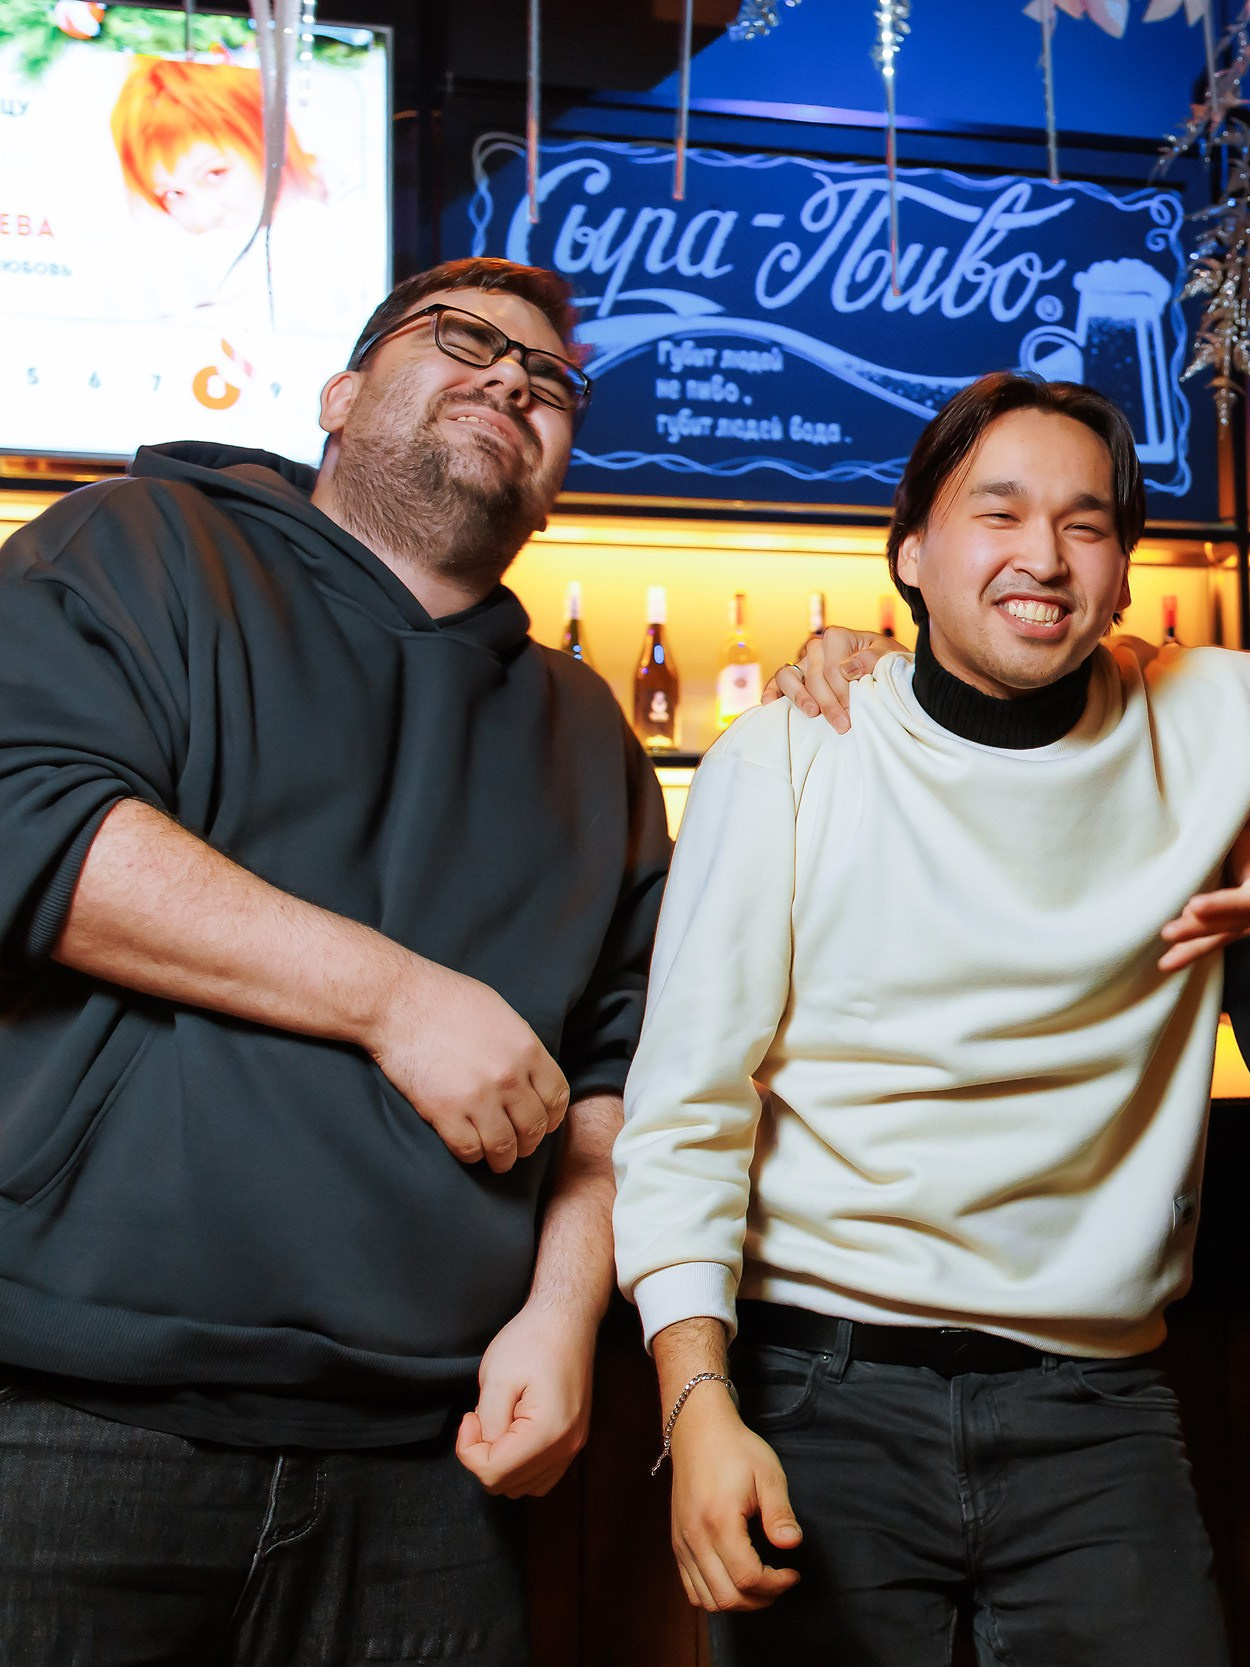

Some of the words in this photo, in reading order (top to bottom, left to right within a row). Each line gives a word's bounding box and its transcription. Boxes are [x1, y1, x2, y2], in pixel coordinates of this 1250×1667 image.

[27, 367, 39, 385] 5
[88, 370, 102, 389] 6
[152, 373, 162, 391] 7
[269, 382, 282, 399] 9
